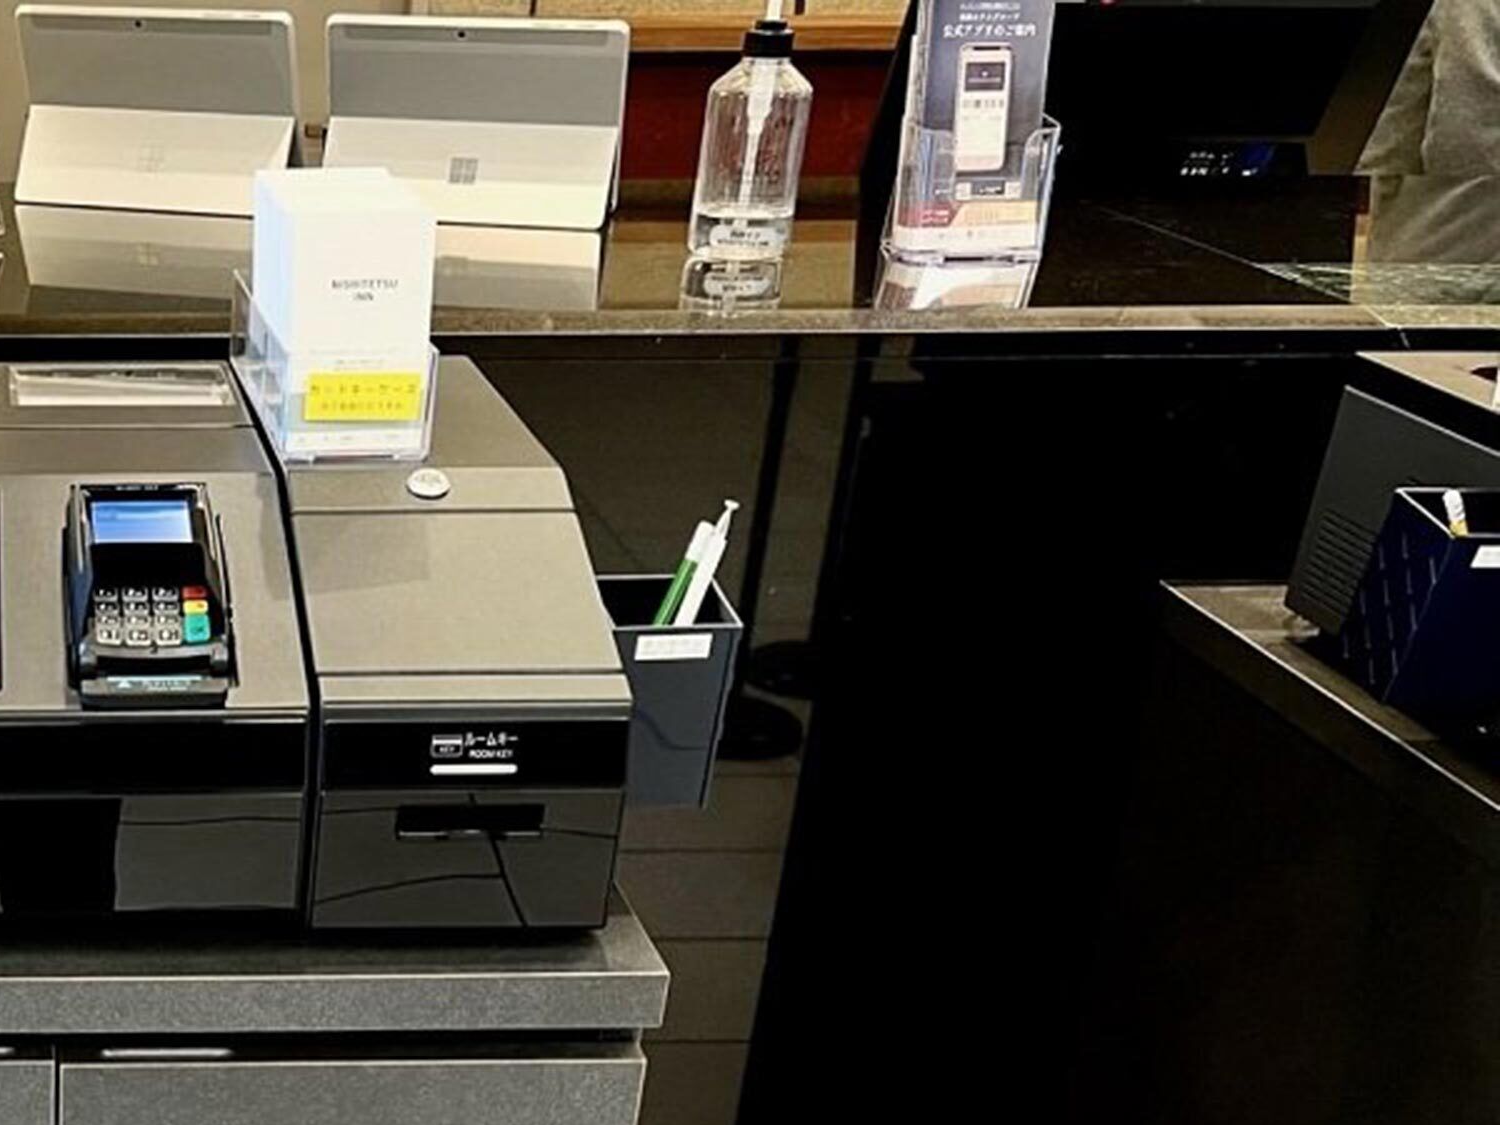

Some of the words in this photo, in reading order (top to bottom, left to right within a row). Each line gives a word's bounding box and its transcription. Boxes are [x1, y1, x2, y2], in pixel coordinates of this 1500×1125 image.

[465, 732, 518, 746] ルームキー
[468, 749, 495, 758] ROOM
